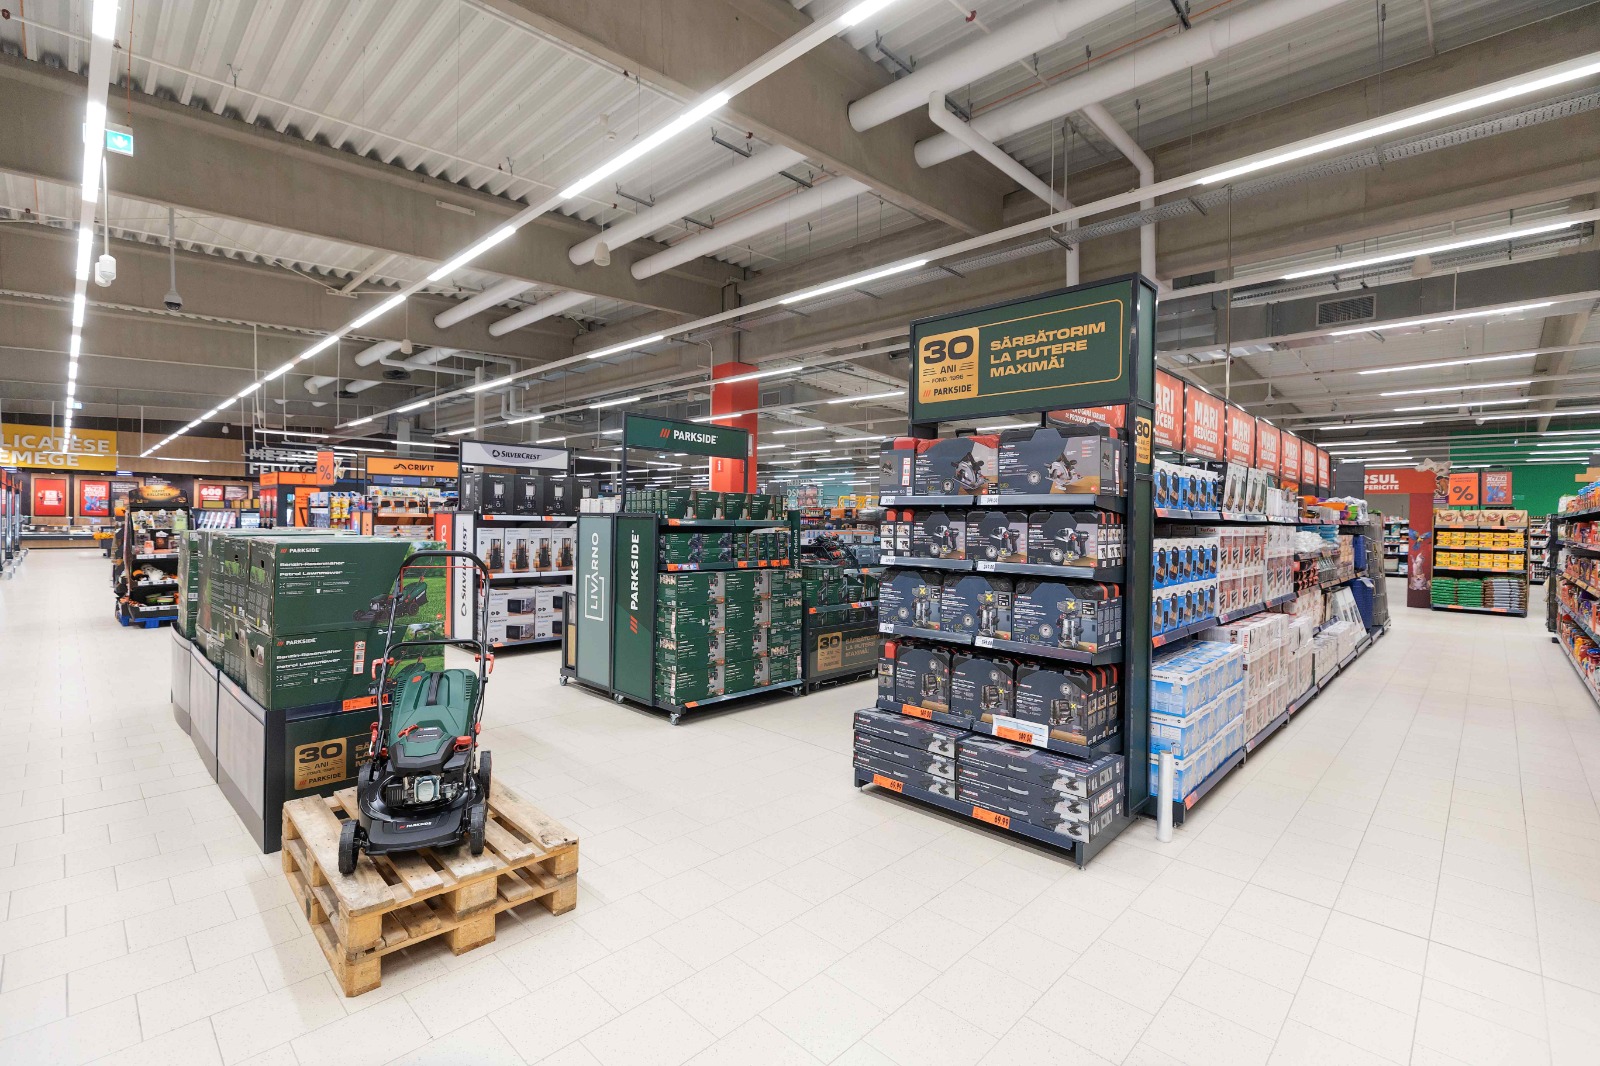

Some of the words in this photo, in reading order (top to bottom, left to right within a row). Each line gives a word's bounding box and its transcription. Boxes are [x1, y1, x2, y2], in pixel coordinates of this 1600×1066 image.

[990, 321, 1106, 351] SĂRBĂTORIM
[923, 335, 974, 364] 30
[990, 352, 1012, 365] LA
[1015, 339, 1088, 360] PUTERE
[940, 365, 957, 374] ANI
[990, 355, 1065, 378] MAXIMĂ!
[933, 384, 972, 396] PARKSIDE
[1194, 400, 1218, 431] MARI
[673, 430, 717, 444] PARKSIDE
[1136, 421, 1150, 438] 30
[1193, 424, 1217, 444] REDUCERI
[1232, 417, 1250, 443] MARI
[1261, 430, 1277, 453] MARI
[501, 450, 540, 460] SILVERCREST
[201, 488, 222, 496] 600
[590, 532, 599, 610] LIVARNO
[630, 534, 640, 611] PARKSIDE
[286, 638, 316, 646] PARKSIDE
[819, 636, 840, 649] 30
[299, 742, 343, 764] 30
[314, 761, 329, 769] ANI
[308, 773, 341, 784] PARKSIDE
[994, 816, 1009, 827] 69.99
